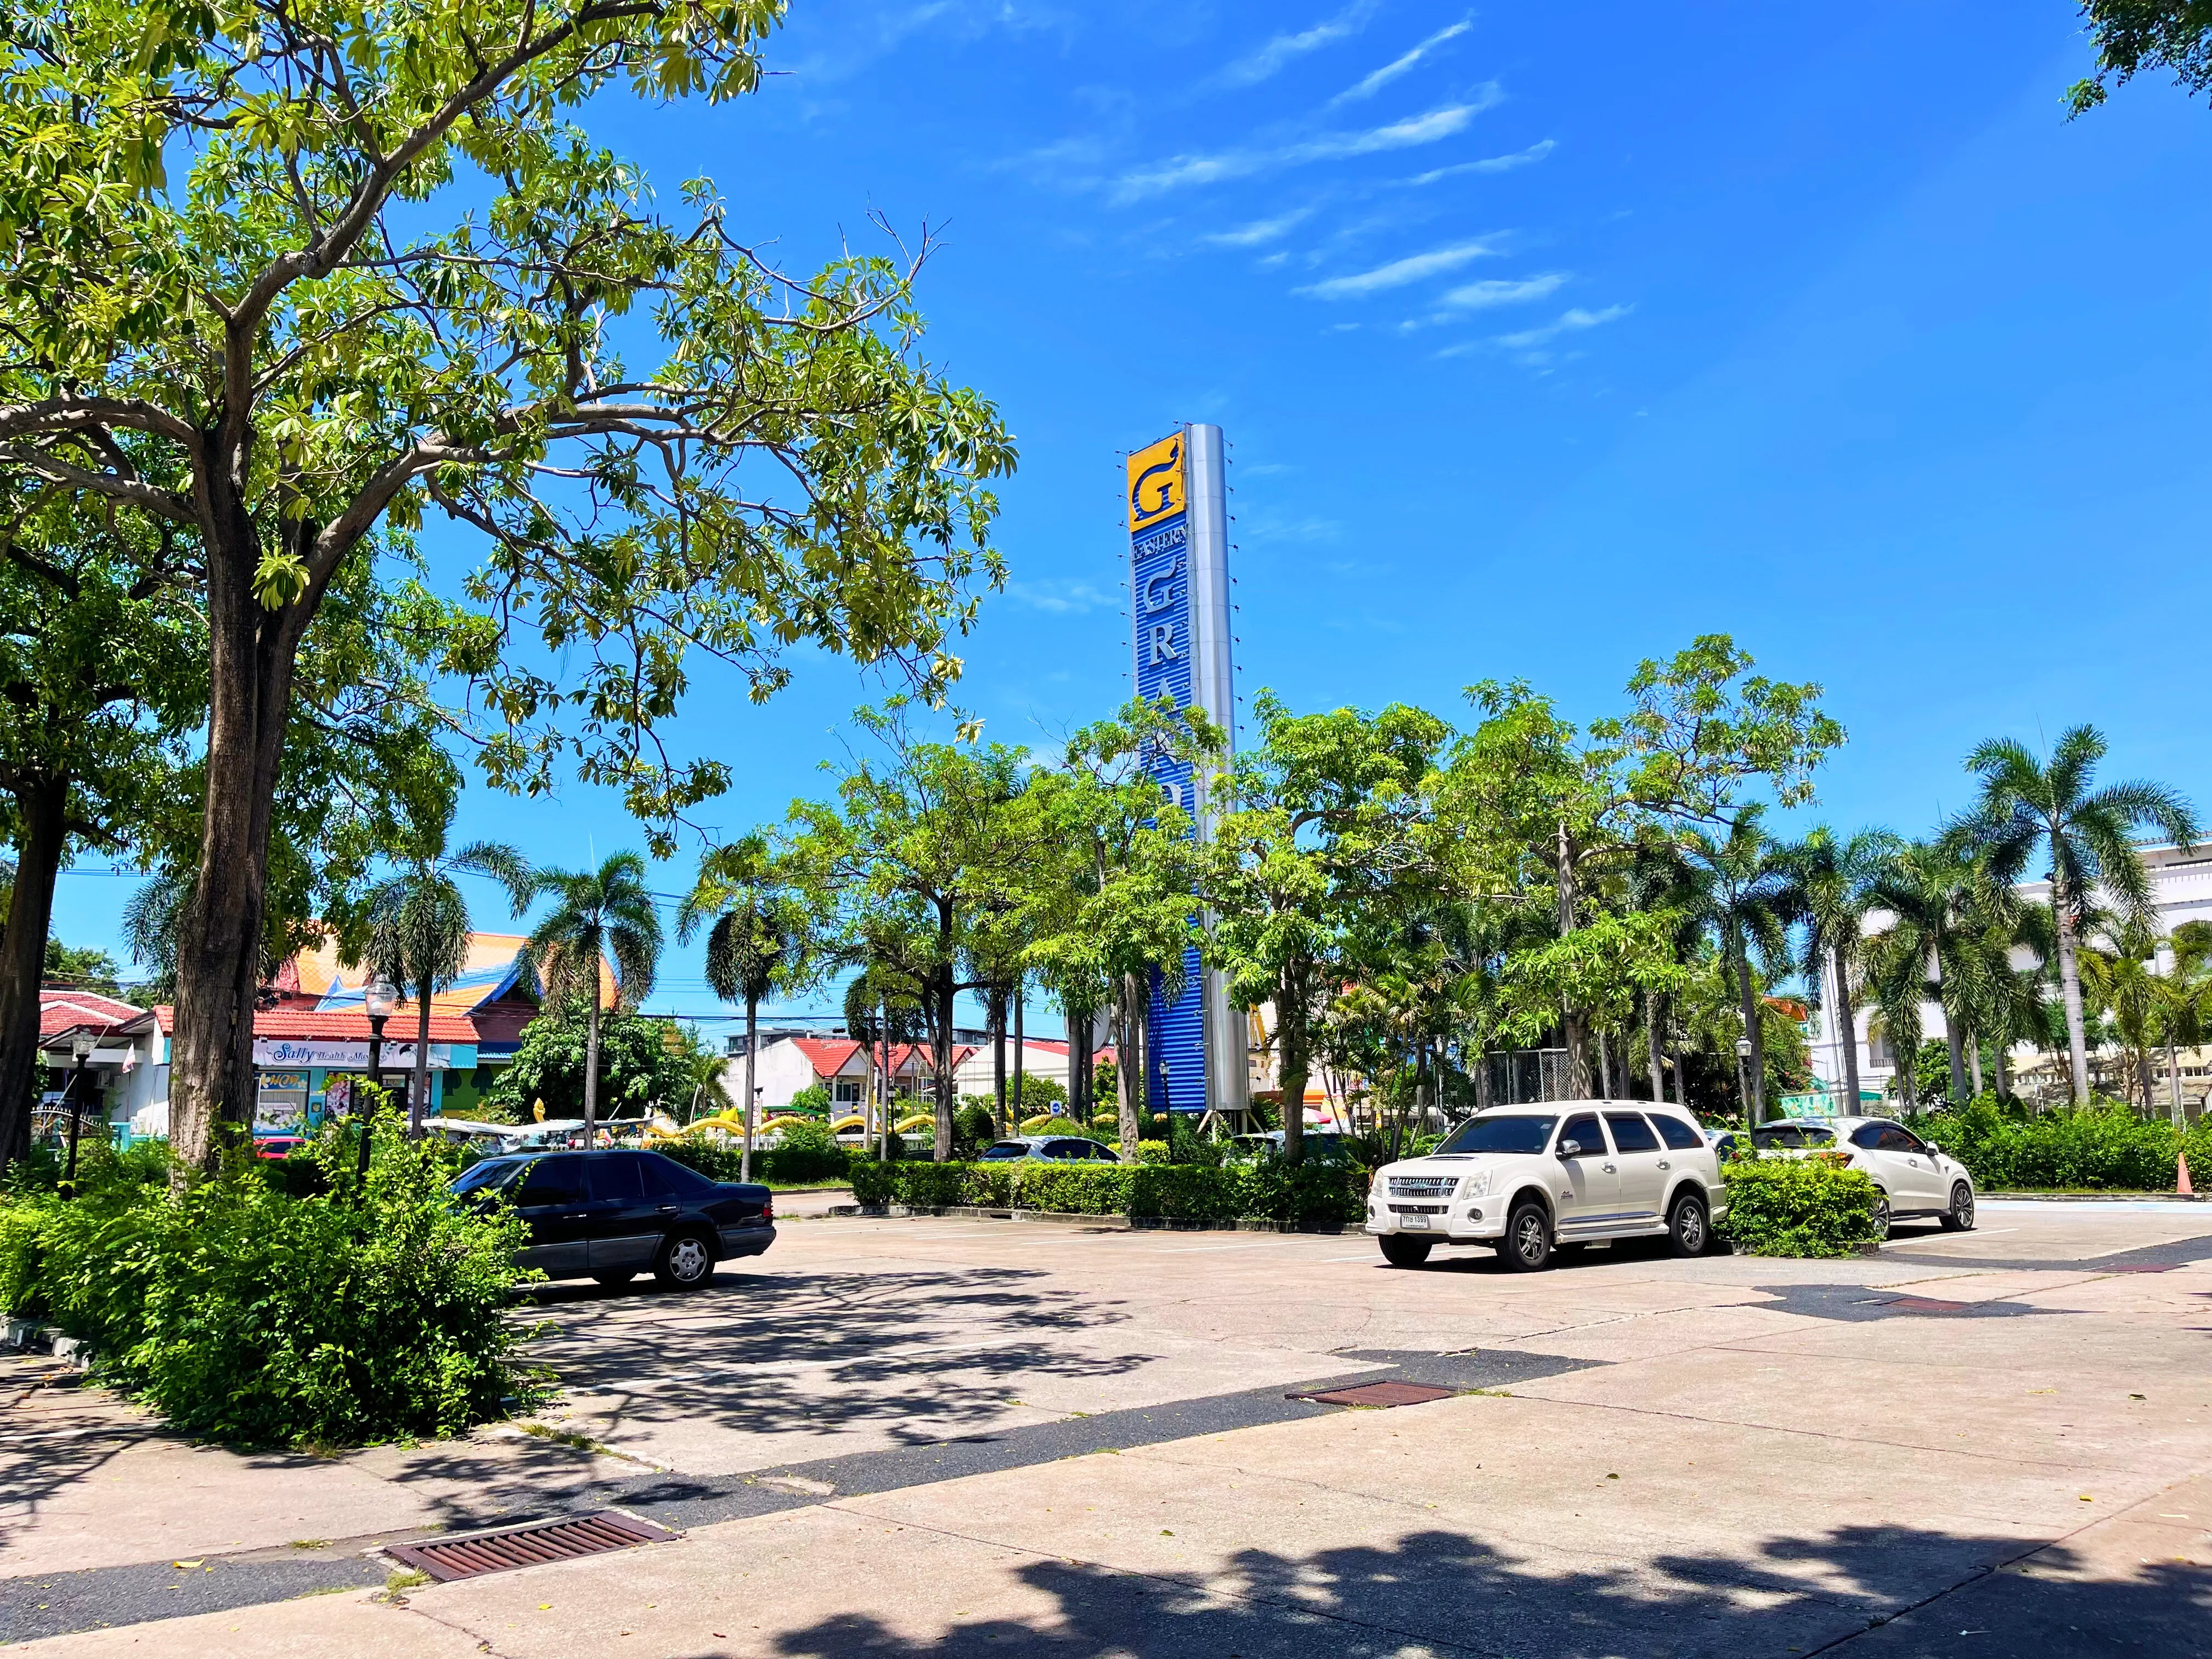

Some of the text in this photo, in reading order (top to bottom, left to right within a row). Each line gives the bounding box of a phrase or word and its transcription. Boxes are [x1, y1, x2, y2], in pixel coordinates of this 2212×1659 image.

[1132, 441, 1180, 522] G
[1131, 524, 1187, 561] EASTERN
[274, 1043, 314, 1063] Sally
[317, 1051, 346, 1060] Health
